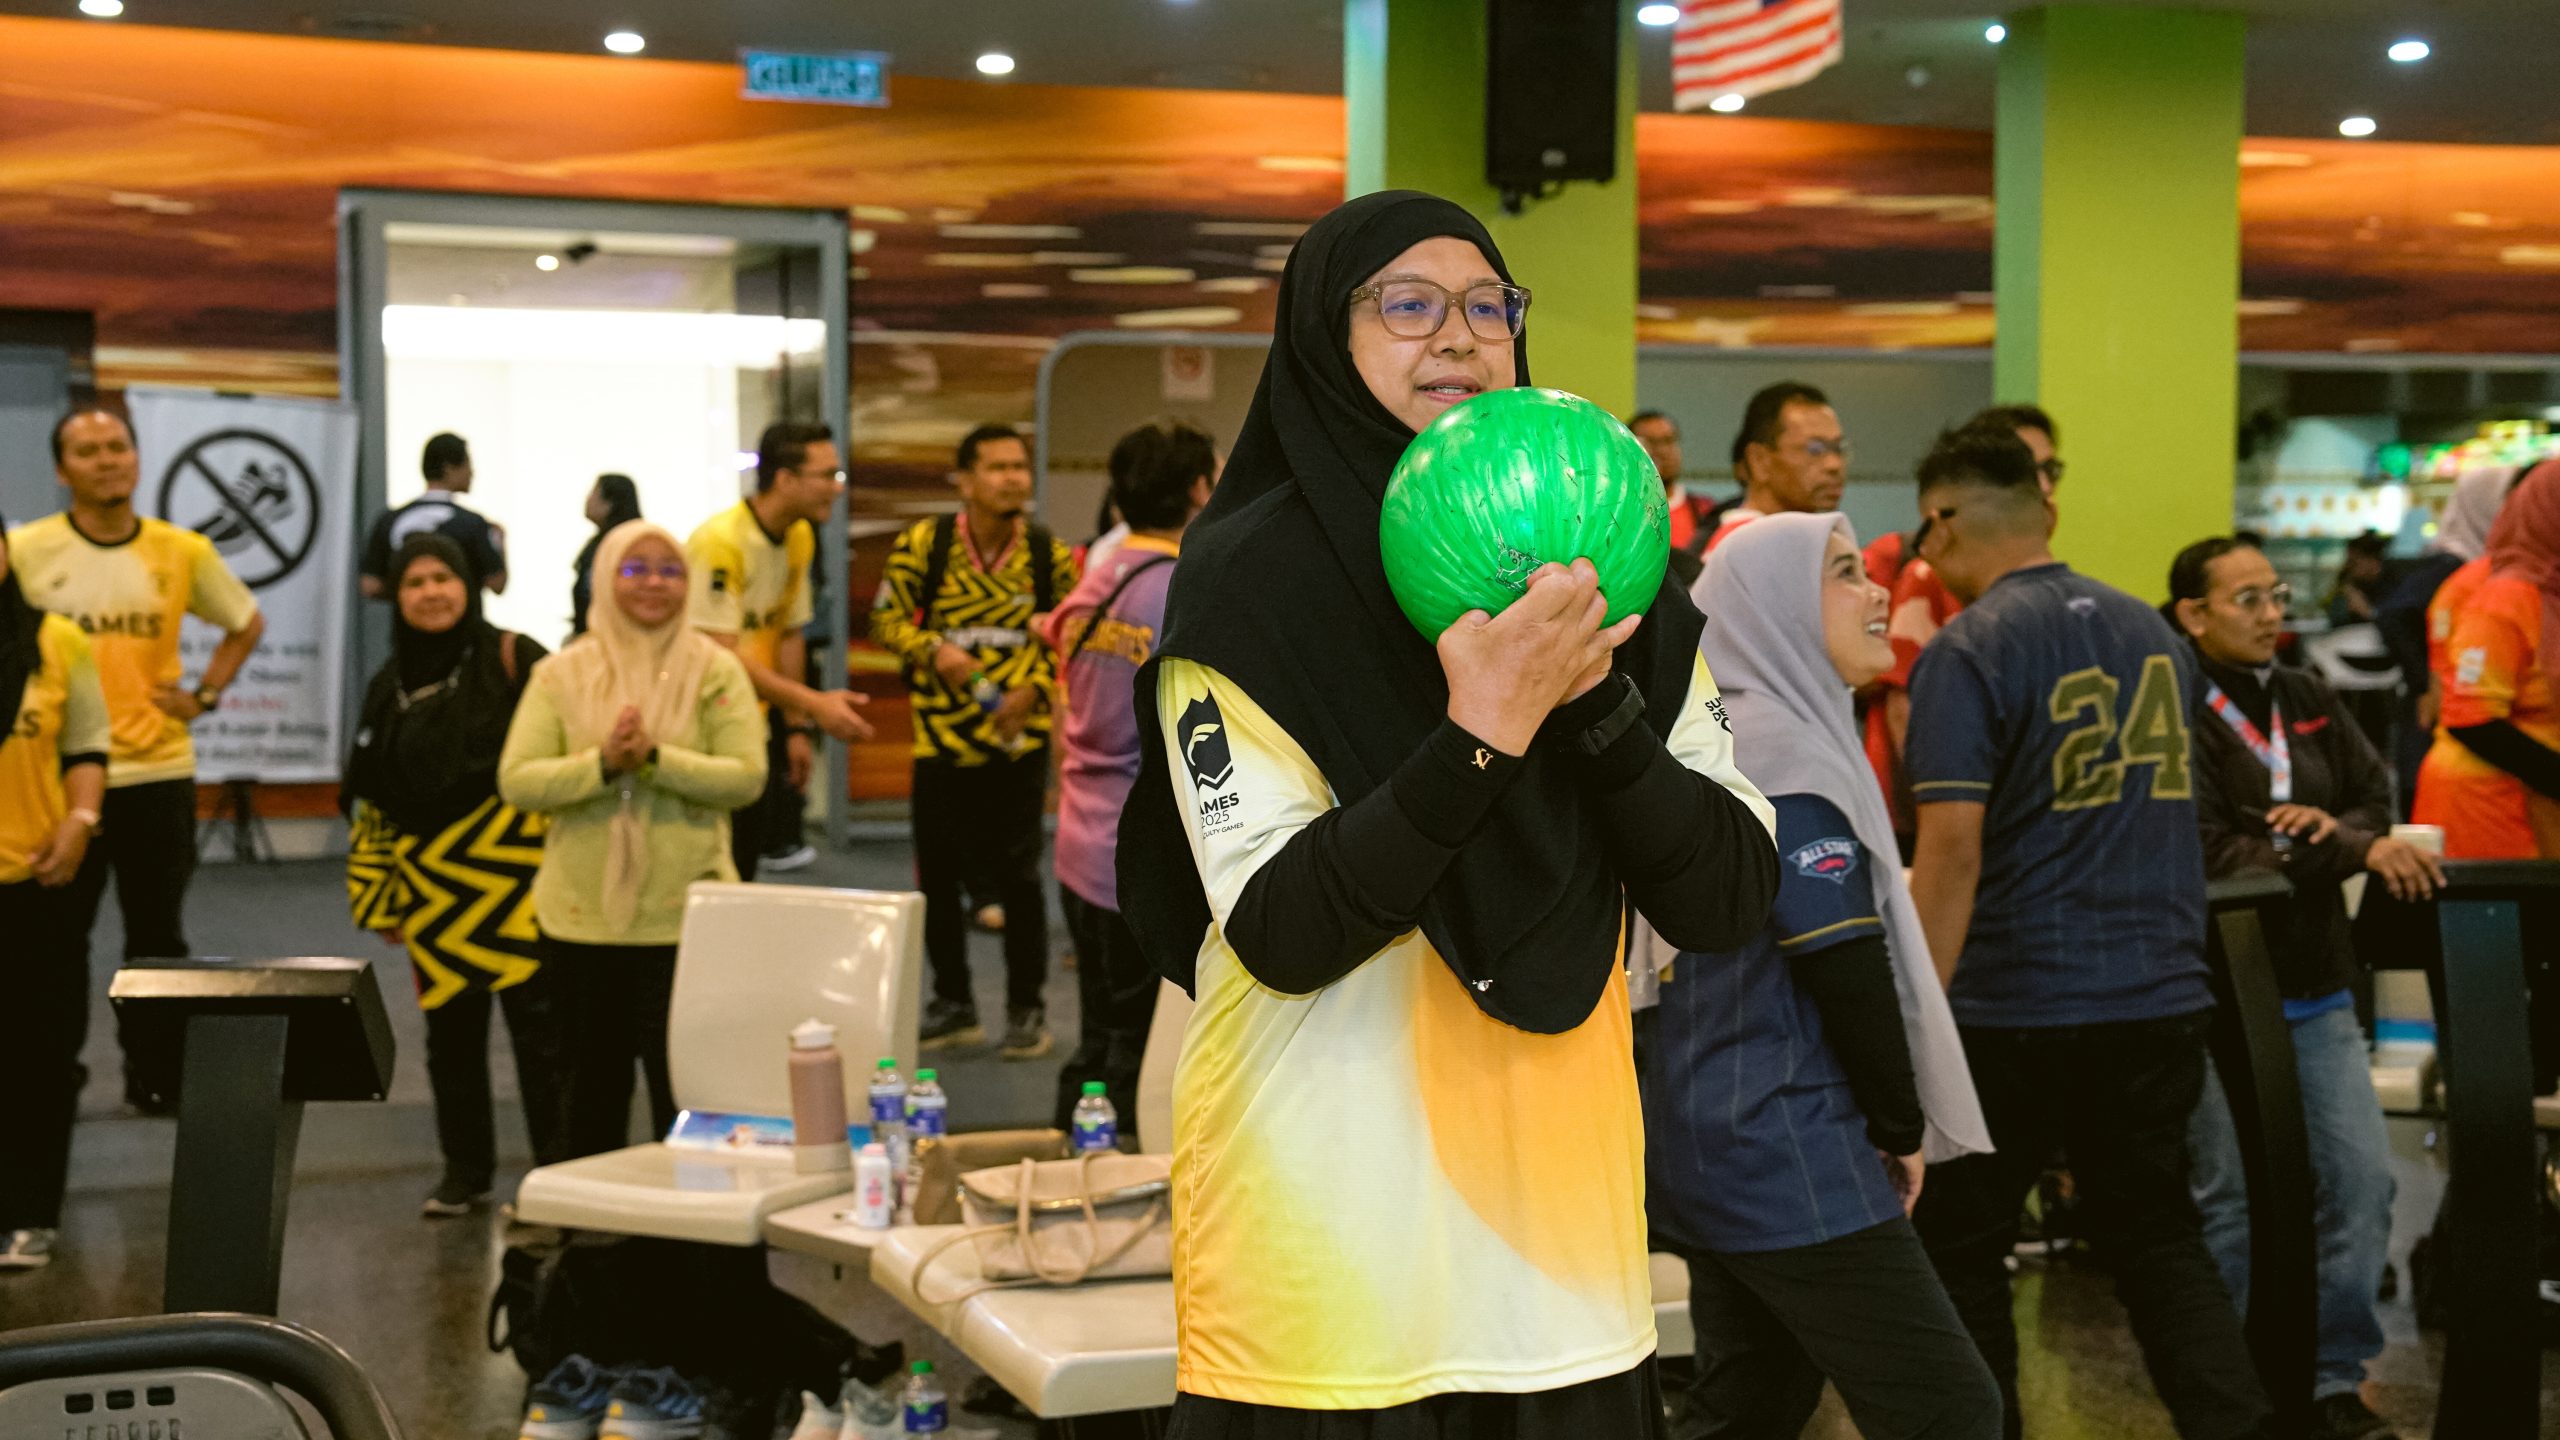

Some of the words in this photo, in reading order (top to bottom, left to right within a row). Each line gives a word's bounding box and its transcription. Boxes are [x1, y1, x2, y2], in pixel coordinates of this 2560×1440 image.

[63, 610, 163, 639] AMES
[2049, 653, 2193, 812] 24
[1221, 821, 1244, 833] GAMES
